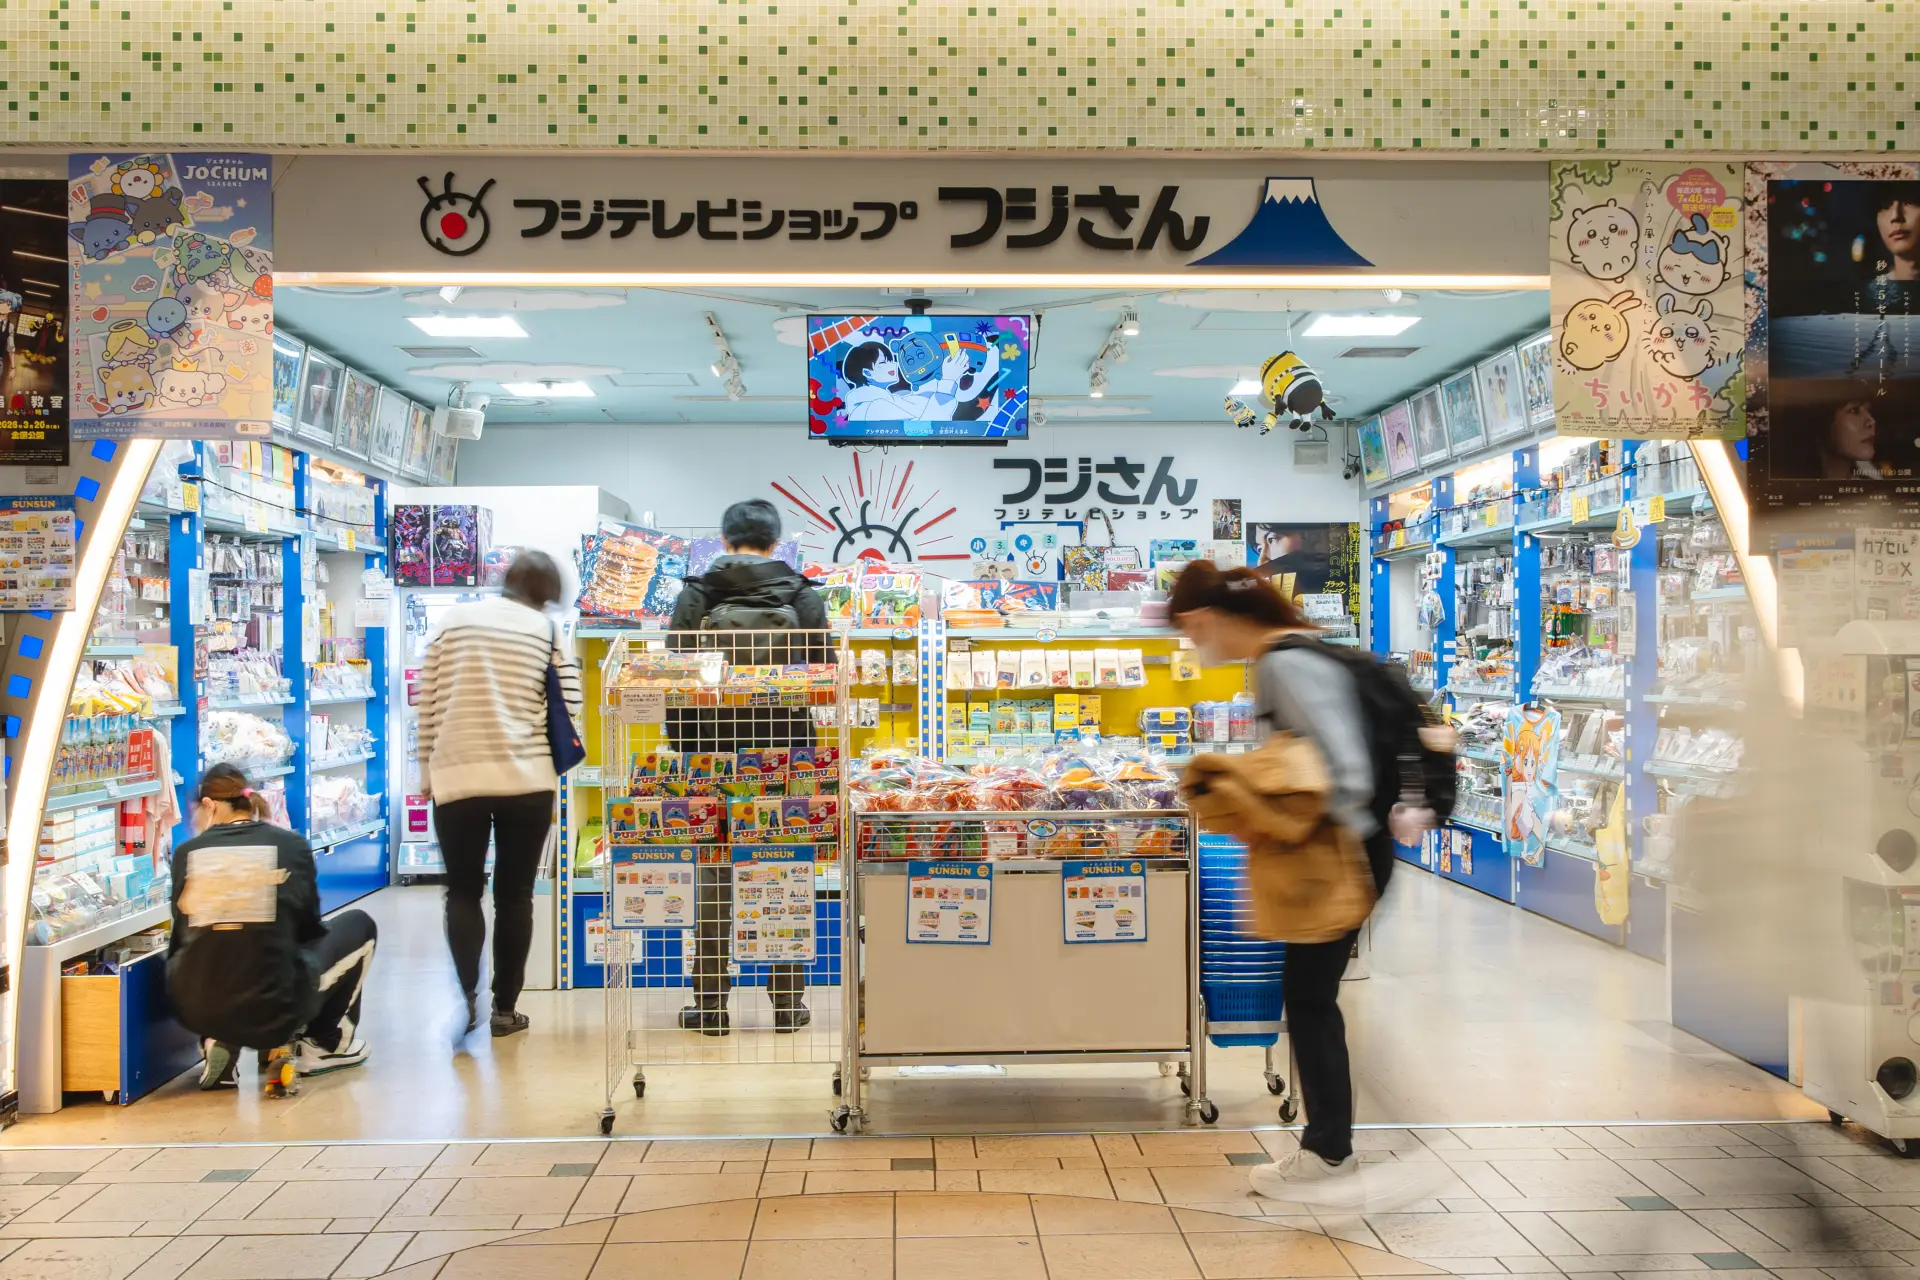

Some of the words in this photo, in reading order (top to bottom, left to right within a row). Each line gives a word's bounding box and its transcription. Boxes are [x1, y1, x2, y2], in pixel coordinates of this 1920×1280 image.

[182, 166, 268, 181] JOCHUM
[513, 198, 918, 240] フジテレビショップ
[938, 186, 1210, 250] フジさん
[1876, 260, 1888, 396] 秒速5センチメートル
[1584, 378, 1713, 410] ちいかわ
[994, 456, 1198, 506] フジさん
[12, 500, 56, 508] SUNSUN
[994, 508, 1198, 520] フジテレビショップ
[973, 540, 983, 550] 小
[1863, 537, 1909, 555] カプセル
[862, 576, 912, 589] SUN
[634, 776, 680, 784] PUPPET
[686, 777, 734, 786] PUPPET
[736, 772, 784, 782] SUNSUN
[790, 768, 838, 779] SUNSUN
[613, 829, 661, 839] PUPPET
[663, 826, 713, 835] SUNSUN
[733, 828, 782, 839] PUPPET
[782, 824, 834, 835] SUNSUN
[928, 867, 972, 875] SUNSUN
